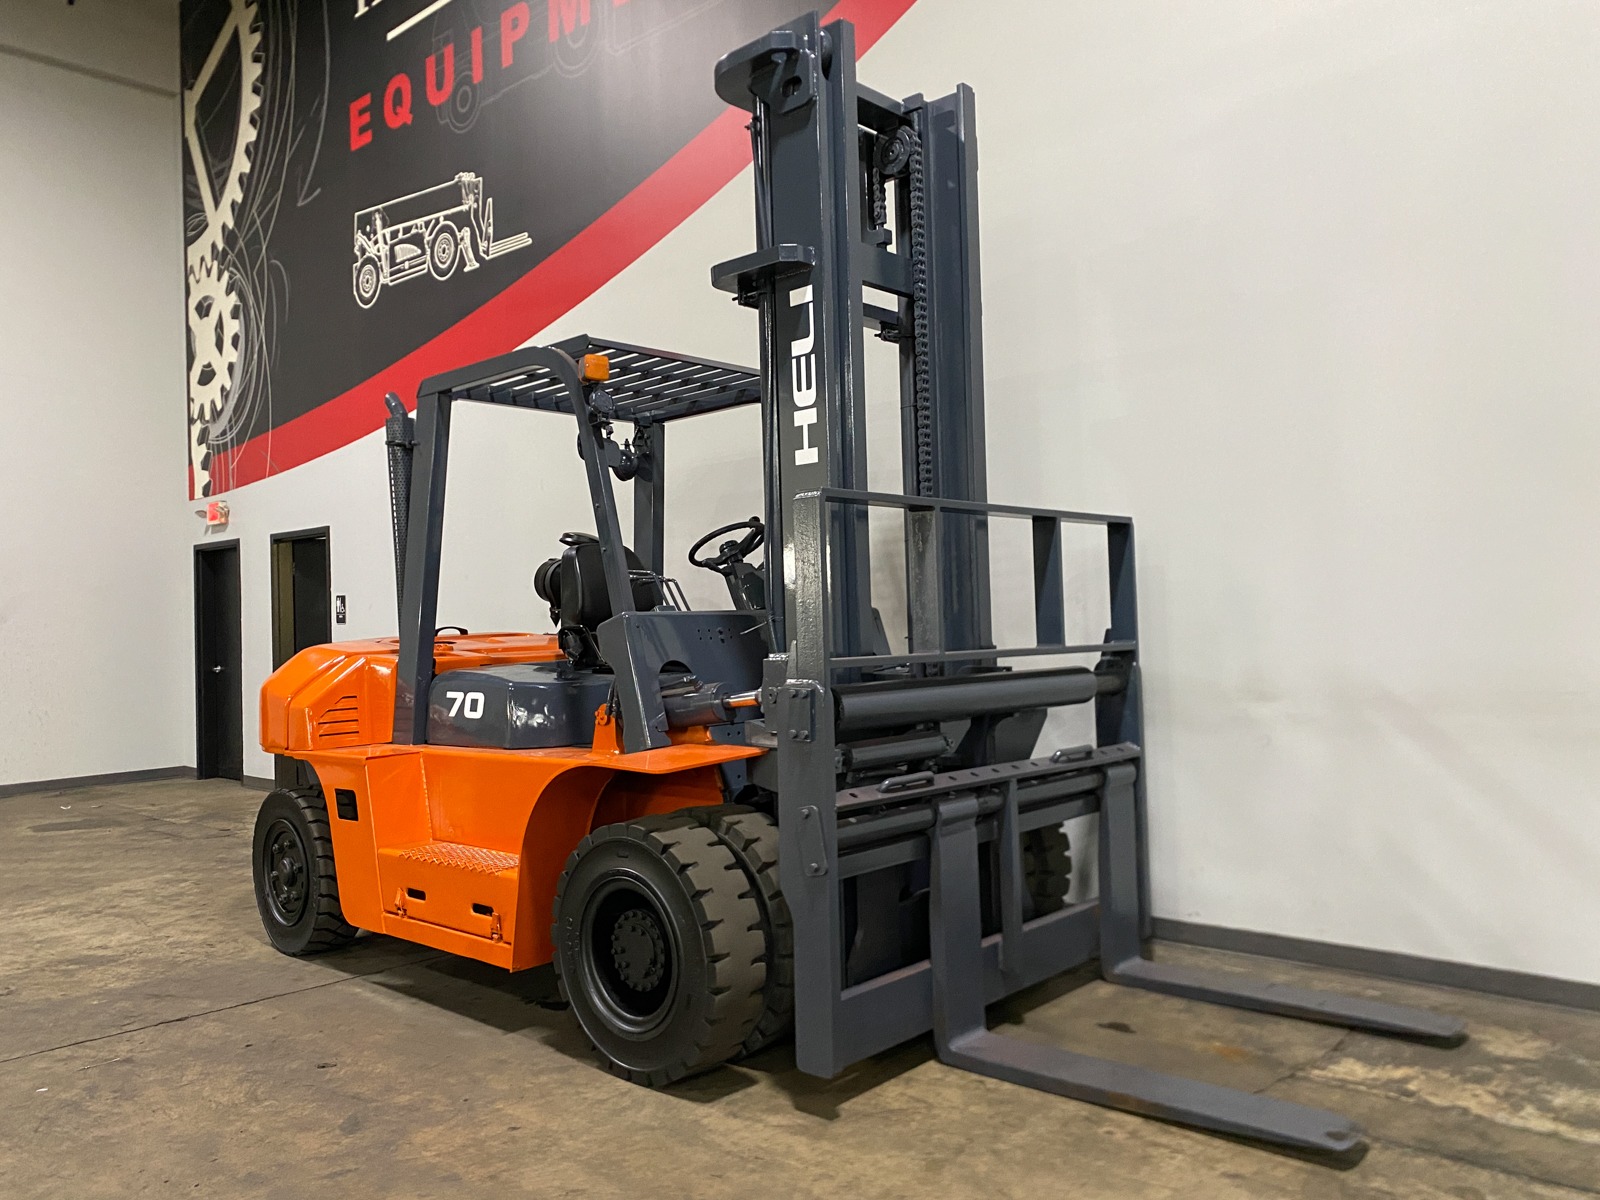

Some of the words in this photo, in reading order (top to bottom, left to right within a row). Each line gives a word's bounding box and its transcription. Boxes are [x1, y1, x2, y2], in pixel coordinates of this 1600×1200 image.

[349, 0, 629, 151] EQUIPM
[789, 284, 818, 466] HELI
[446, 691, 485, 719] 70
